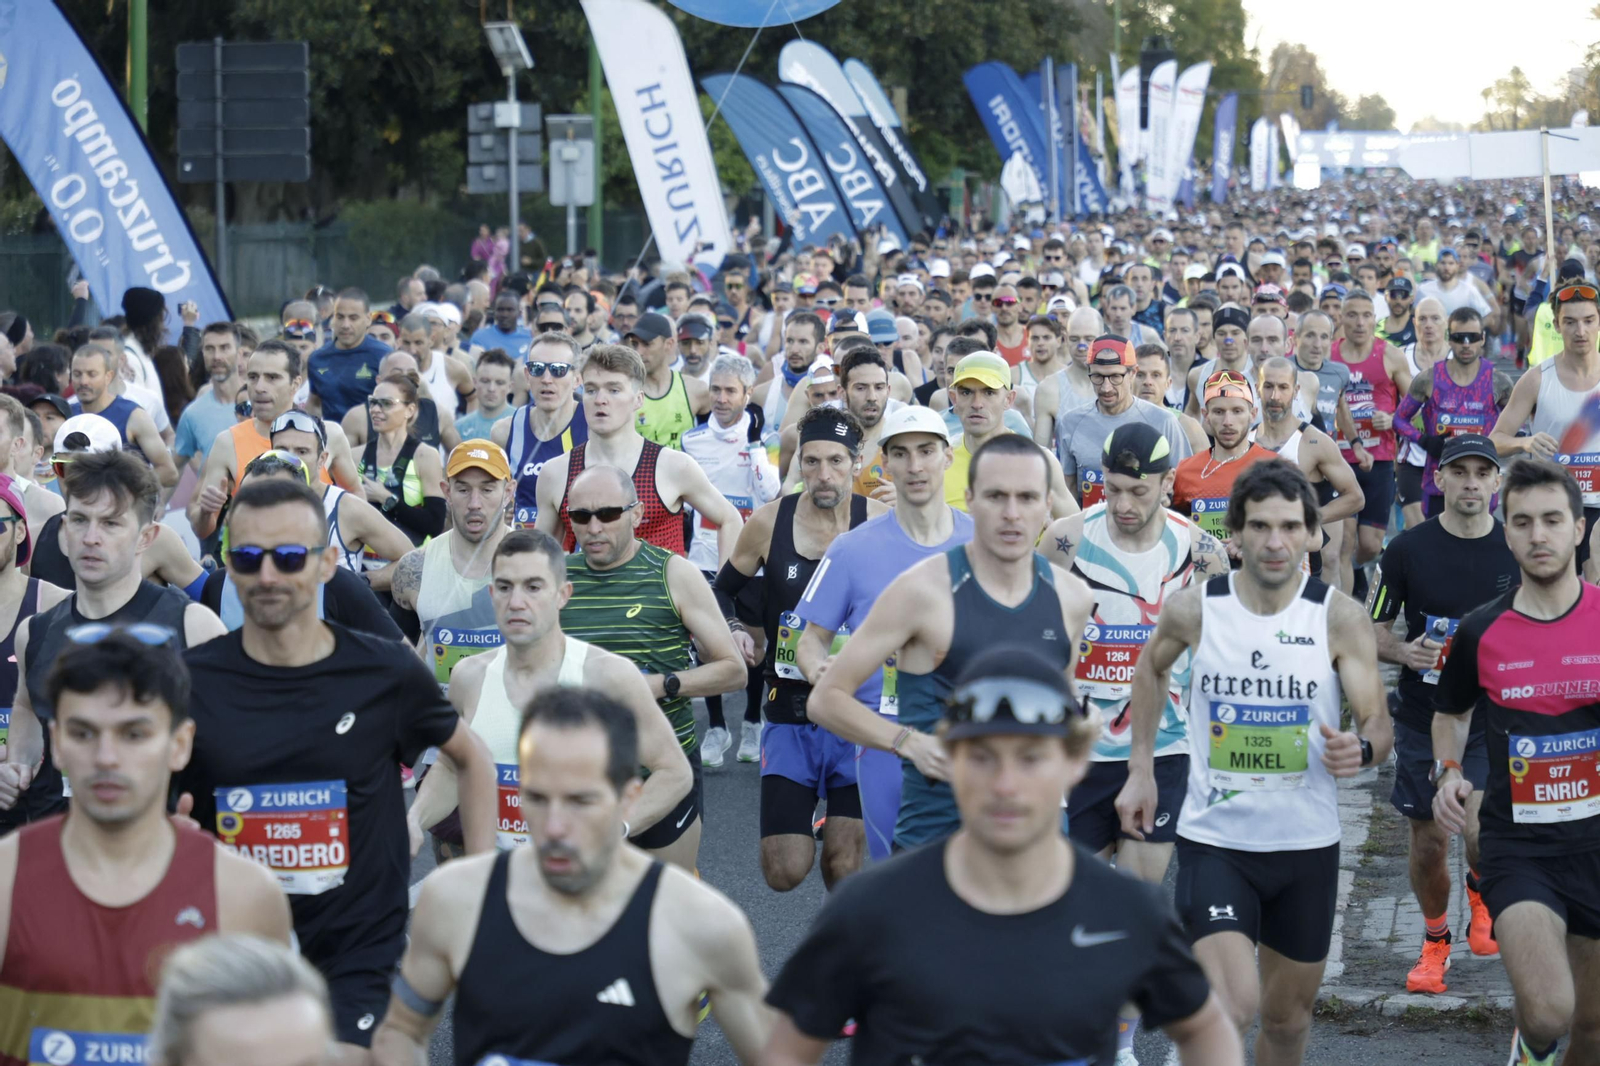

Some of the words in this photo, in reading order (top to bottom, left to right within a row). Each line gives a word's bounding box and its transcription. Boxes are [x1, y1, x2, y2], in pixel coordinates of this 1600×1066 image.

[1574, 470, 1592, 478] 1137
[457, 633, 501, 644] ZURICH
[1105, 630, 1151, 640] ZURICH
[777, 647, 797, 663] RO
[1105, 651, 1130, 662] 1264
[1241, 710, 1297, 723] ZURICH
[1244, 736, 1272, 748] 1325
[1542, 736, 1596, 754] ZURICH
[1230, 751, 1286, 770] MIKEL
[1549, 765, 1572, 779] 977
[1534, 779, 1589, 802] ENRIC
[260, 789, 331, 807] ZURICH
[505, 794, 522, 808] 10
[264, 822, 302, 840] 1265
